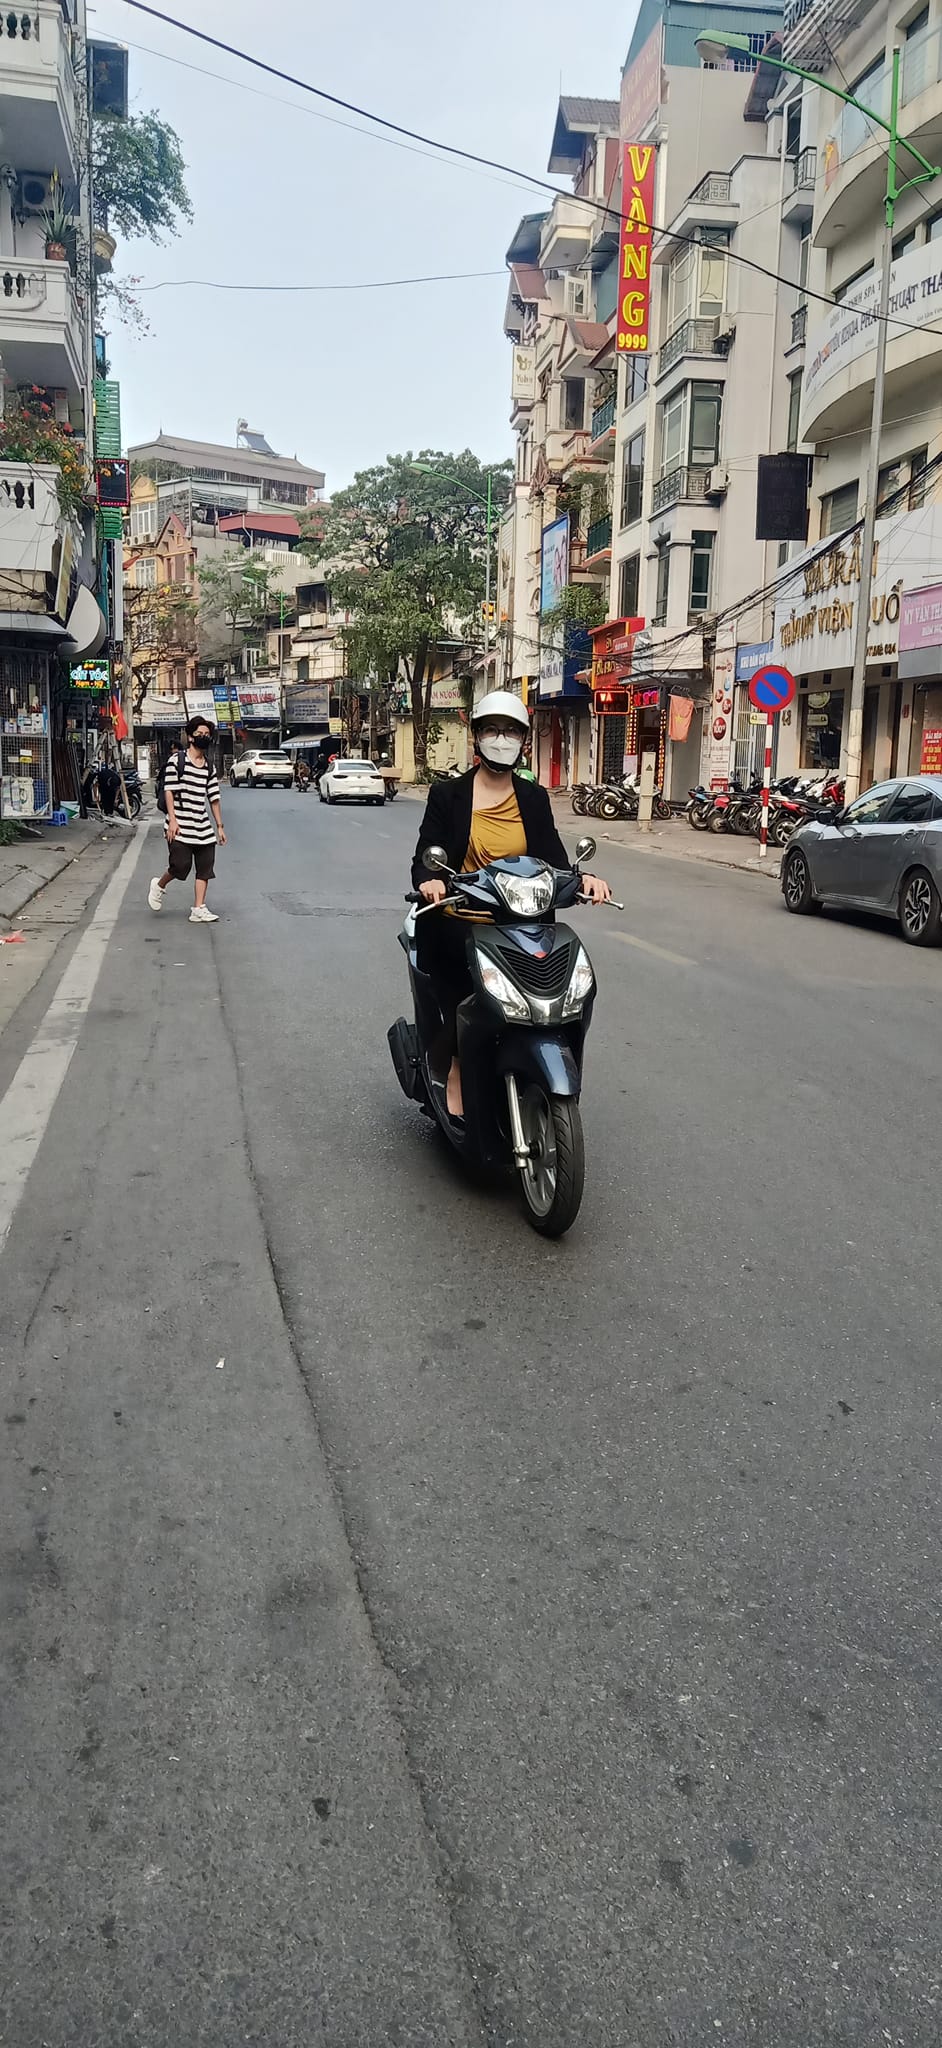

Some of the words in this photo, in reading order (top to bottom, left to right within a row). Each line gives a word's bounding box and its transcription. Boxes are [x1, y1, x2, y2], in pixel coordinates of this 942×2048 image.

[623, 146, 652, 326] VÀNG
[618, 333, 647, 349] 9999
[818, 597, 854, 638] VIỆN
